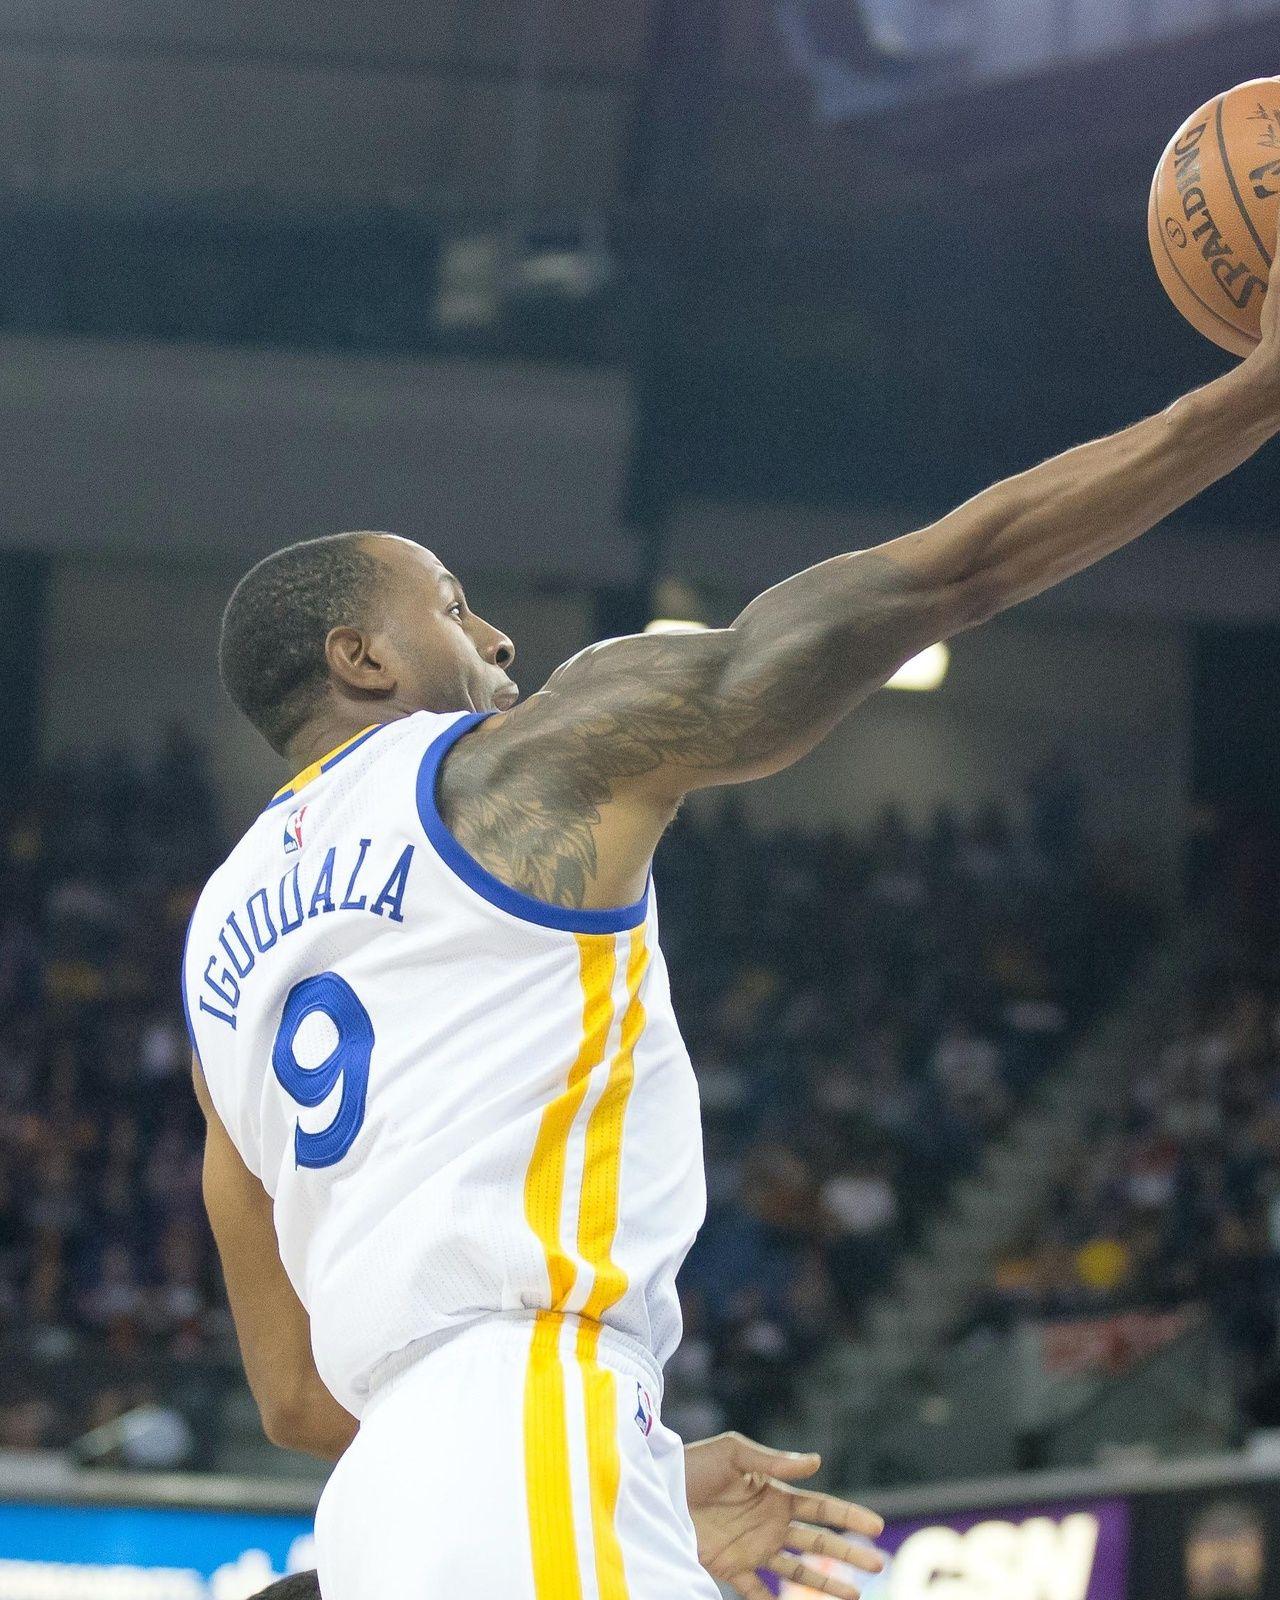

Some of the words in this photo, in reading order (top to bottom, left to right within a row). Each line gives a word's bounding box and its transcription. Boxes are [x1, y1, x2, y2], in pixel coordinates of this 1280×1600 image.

[1174, 119, 1268, 309] SPALDING
[200, 839, 415, 1030] IGUODALA
[272, 971, 375, 1171] 9
